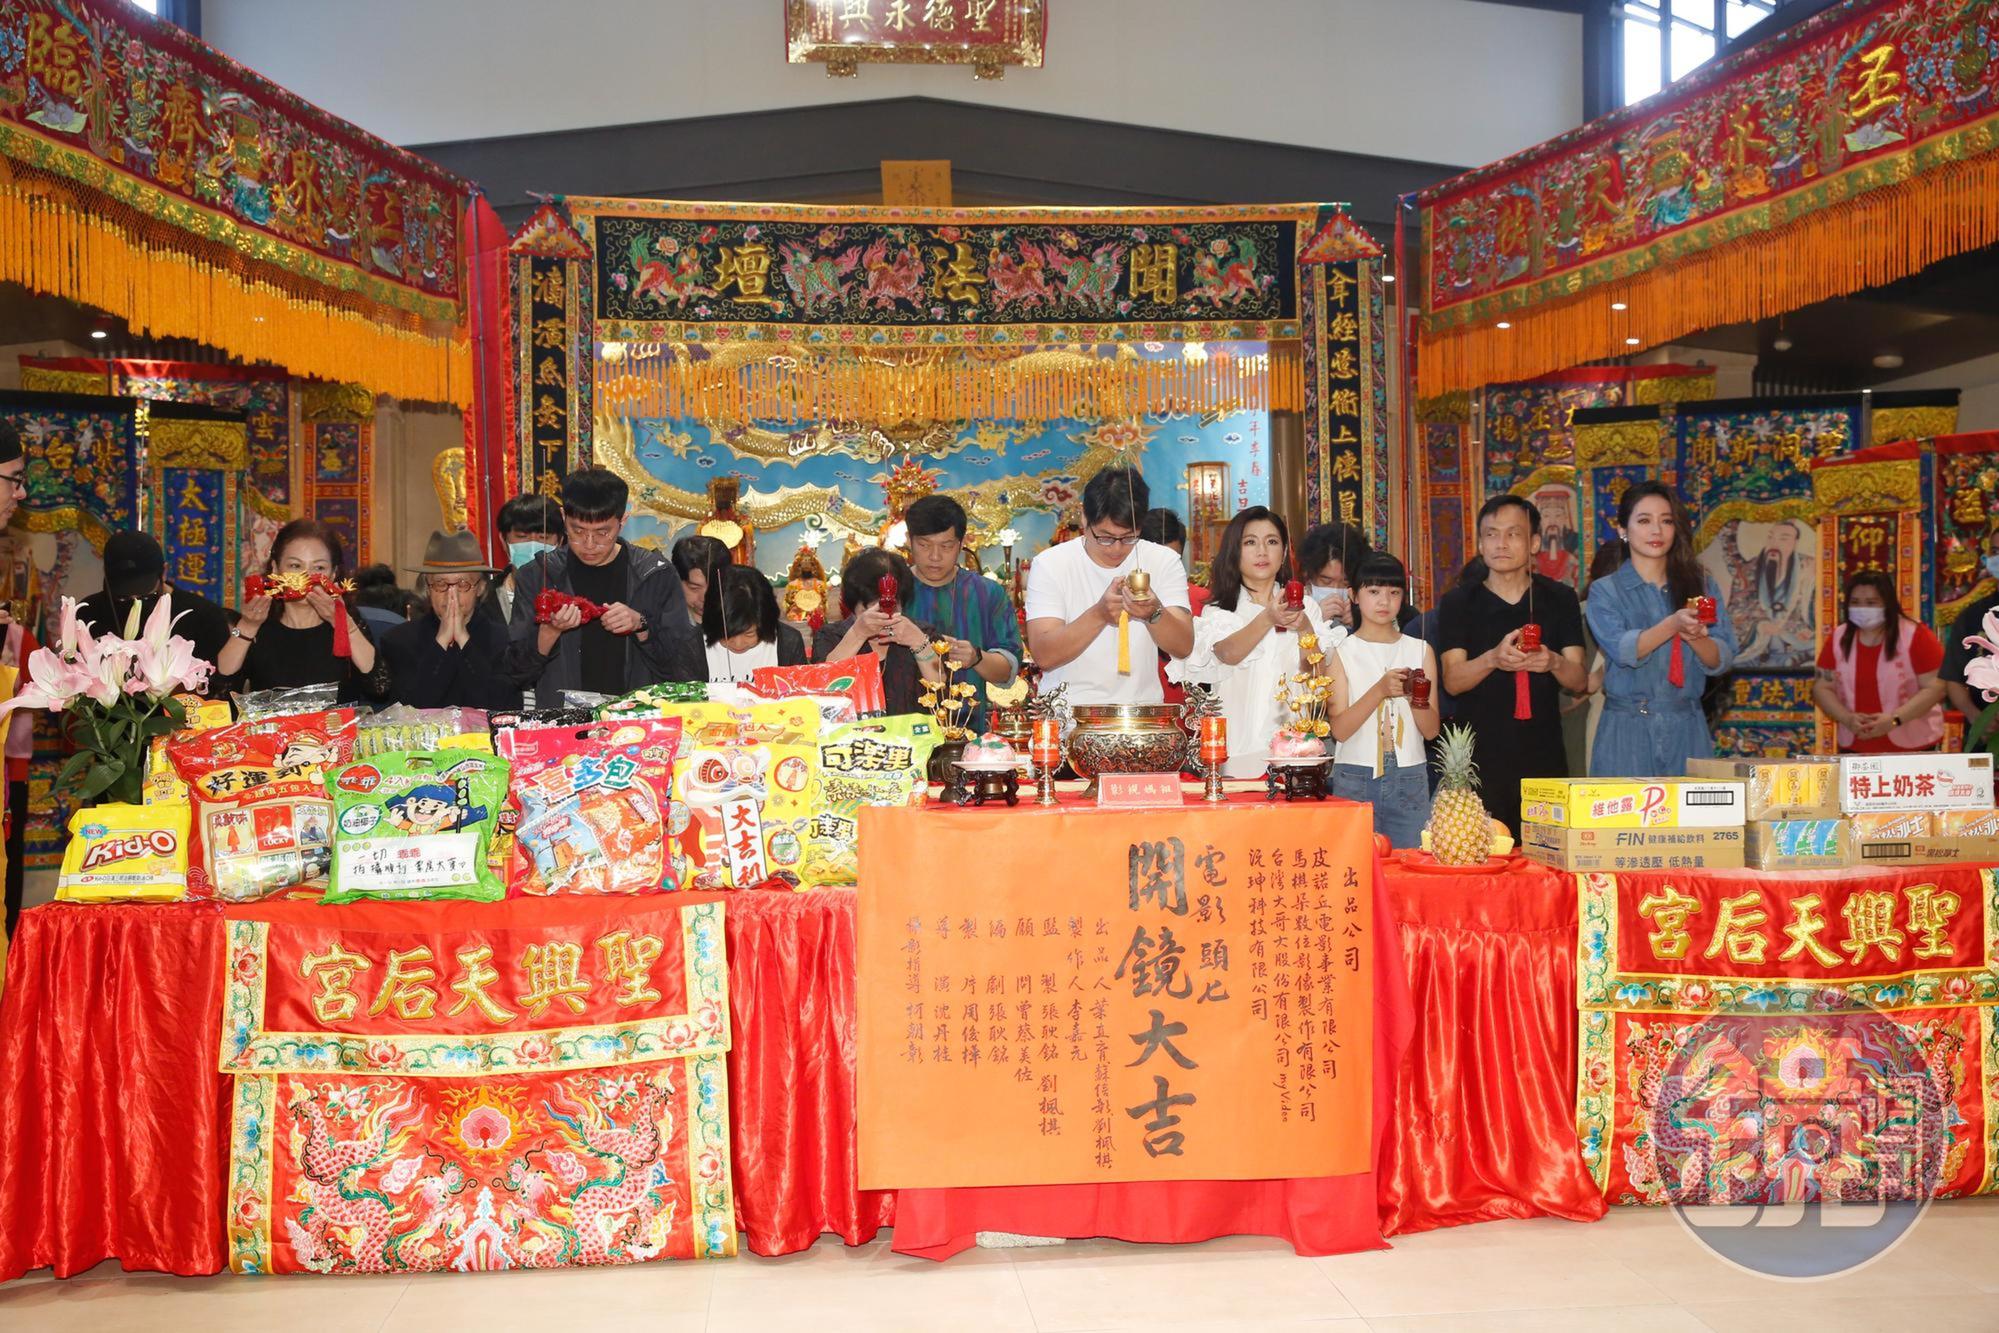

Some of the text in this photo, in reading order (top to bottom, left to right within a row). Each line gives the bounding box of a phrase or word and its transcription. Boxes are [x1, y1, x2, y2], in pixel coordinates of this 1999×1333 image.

[177, 477, 209, 597] 太極運
[531, 754, 638, 804] 喜多包
[1850, 773, 1936, 800] 特上奶茶
[1592, 796, 1633, 817] 維他露
[85, 828, 103, 836] NEW
[358, 848, 387, 861] 一切
[729, 804, 765, 886] 大吉利
[1615, 832, 1645, 846] FIN
[1712, 831, 1740, 842] 2765
[1668, 856, 1705, 869] 低熱量
[1342, 866, 1363, 973] 出品公司
[1637, 883, 1962, 969] 聖興天后宮
[299, 930, 665, 1025] 聖興天后宮
[1114, 836, 1199, 1158] 開鏡大吉
